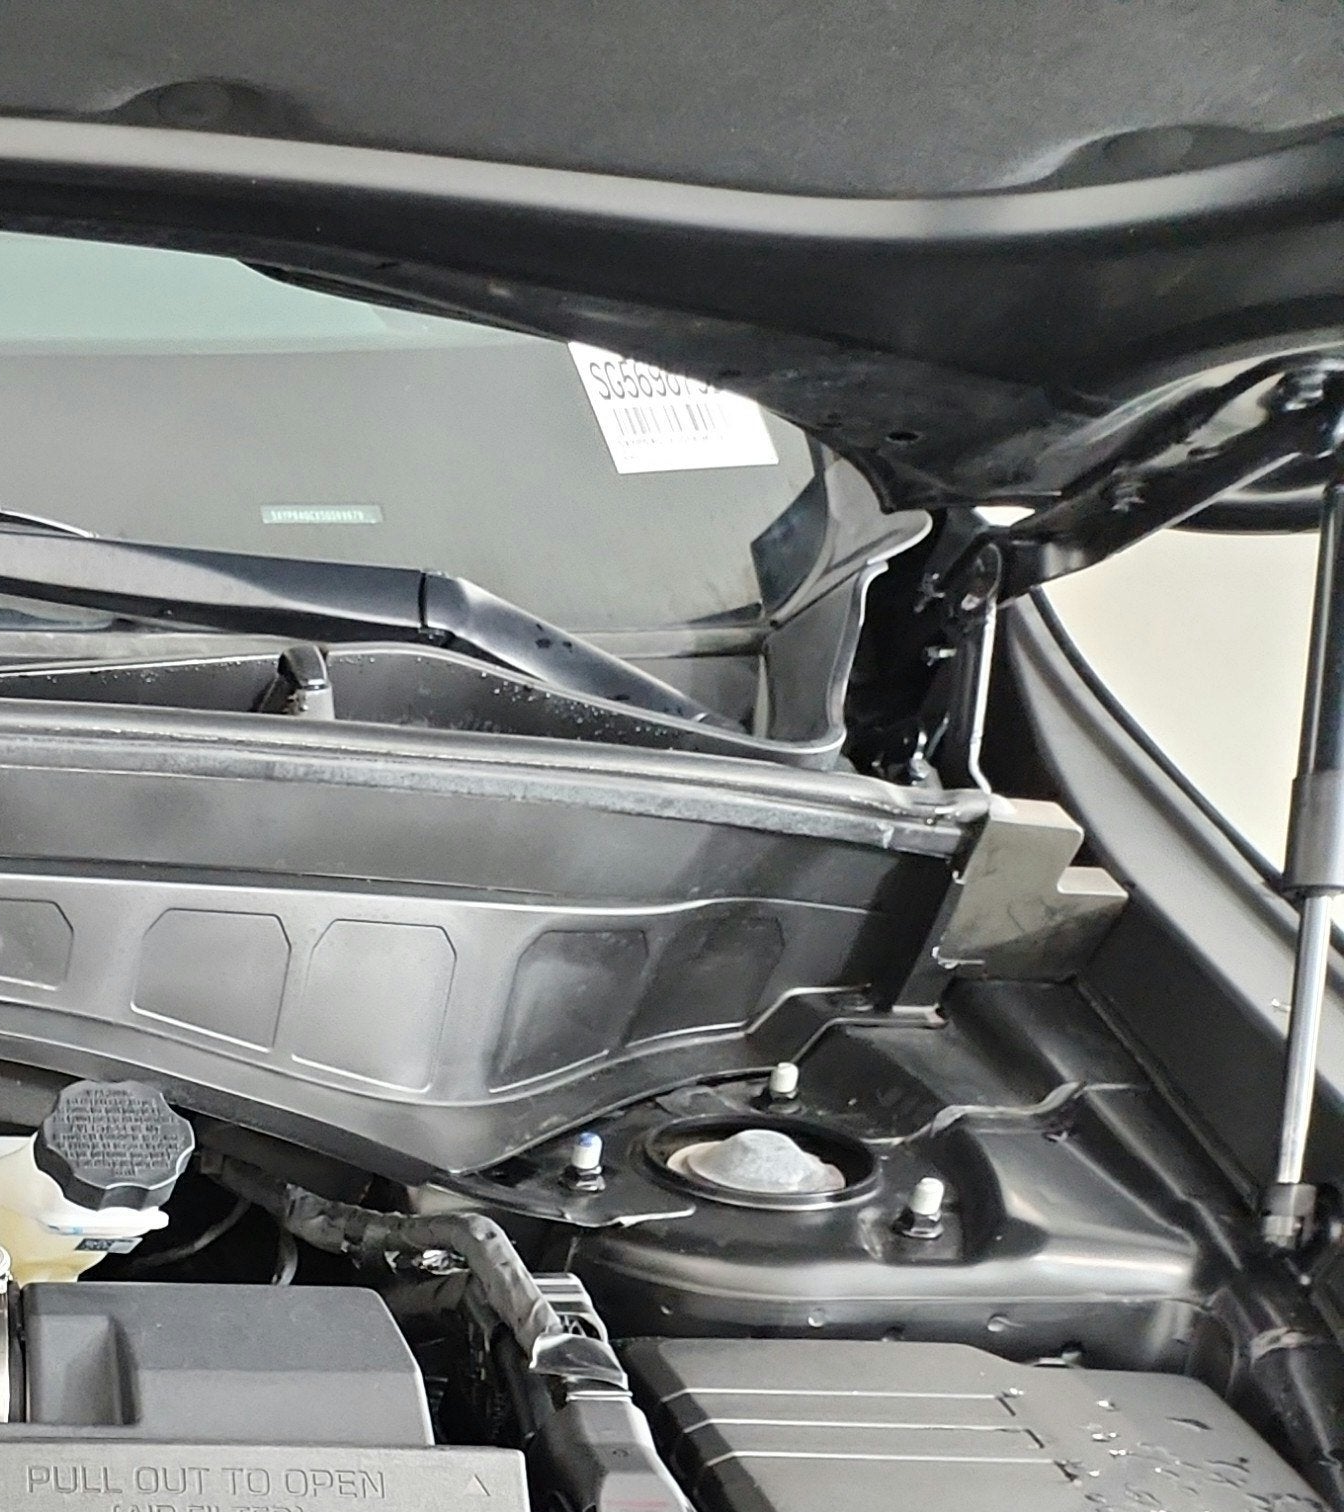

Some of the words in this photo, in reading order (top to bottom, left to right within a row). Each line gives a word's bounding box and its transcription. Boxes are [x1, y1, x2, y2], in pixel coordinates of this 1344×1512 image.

[26, 1464, 123, 1495] PULL
[134, 1464, 210, 1496] OUT
[222, 1467, 272, 1496] TO
[284, 1468, 386, 1500] OPEN
